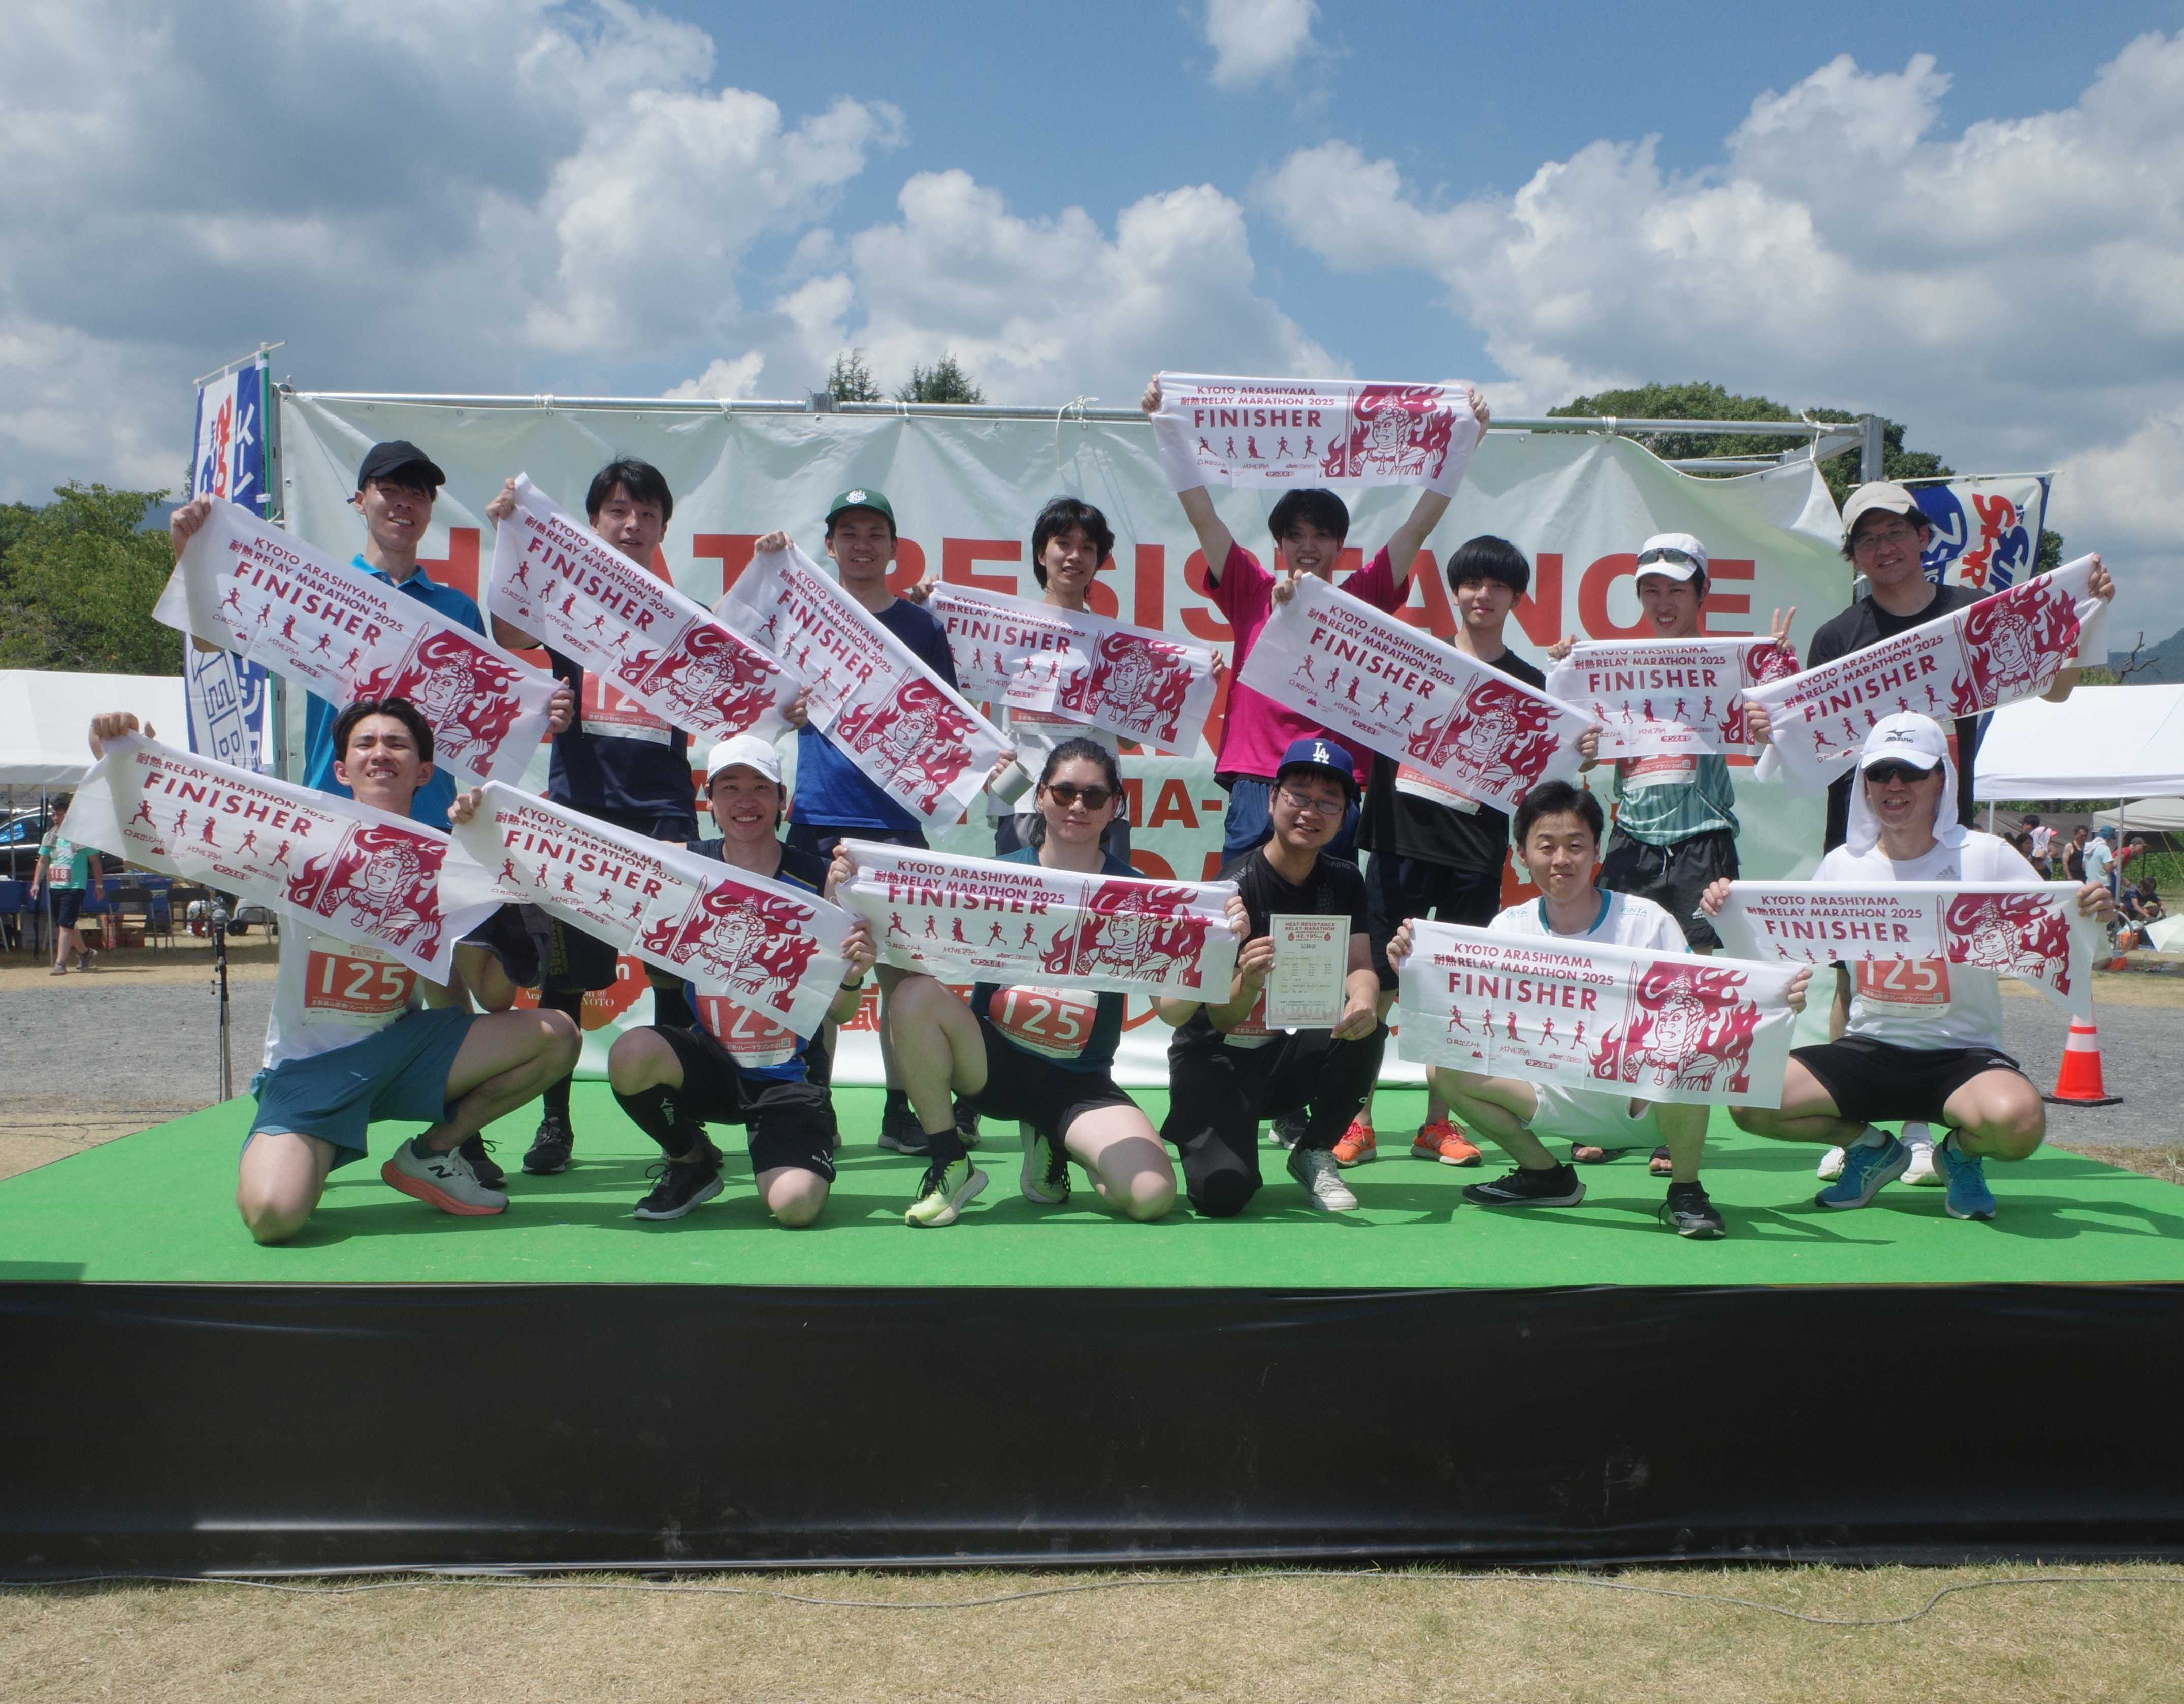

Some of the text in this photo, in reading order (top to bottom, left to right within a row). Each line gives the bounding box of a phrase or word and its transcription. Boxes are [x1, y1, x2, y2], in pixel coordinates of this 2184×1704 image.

[1198, 386, 1316, 395] KYOTO ARASHIYAMA
[1194, 409, 1322, 428] FINISHER
[254, 537, 388, 610] KYOTO ARASHIYAMA
[549, 517, 663, 600] KYOTO ARASHIYAMA
[234, 561, 382, 647] FINISHER
[296, 573, 371, 615] MARATHON
[374, 613, 403, 632] 2025
[527, 536, 654, 632] FINISHER
[581, 555, 647, 600] MARATHON
[648, 598, 676, 619] 2025
[796, 570, 884, 652] KYOTO ARASHIYAMA
[777, 589, 873, 685] FINISHER
[821, 607, 869, 653] MARATHON
[869, 652, 893, 673] 2025
[947, 617, 1070, 655] FINISHER
[1329, 605, 1442, 666] KYOTO ARASHIYAMA
[1310, 627, 1435, 700] FINISHER
[1363, 636, 1427, 671] MARATHON
[1429, 667, 1456, 686] 2025
[1589, 669, 1718, 692] FINISHER
[1633, 657, 1696, 665] MARATHON
[1797, 633, 1921, 691] KYOTO ARASHIYAMA
[1844, 649, 1911, 683] MARATHON
[1915, 635, 1943, 653] 2025
[1803, 655, 1938, 723] FINISHER
[1313, 742, 1329, 764] LA
[144, 771, 312, 838] FINISHER
[212, 776, 297, 809] MARATHON
[518, 806, 663, 867] KYOTO ARASHIYAMA
[568, 835, 646, 871] MARATHON
[51, 869, 66, 879] 118
[504, 830, 662, 899] FINISHER
[897, 861, 1044, 887] KYOTO ARASHIYAMA
[888, 885, 1048, 915] FINISHER
[946, 881, 1027, 899] MARATHON
[1032, 891, 1064, 903] 2025
[1761, 896, 1899, 905] KYOTO ARASHIYAMA
[1810, 908, 1886, 918] MARATHON
[1890, 909, 1922, 919] 2025
[1764, 920, 1910, 943] FINISHER
[1454, 943, 1592, 969] KYOTO ARASHIYAMA
[1501, 962, 1577, 981] MARATHON
[1582, 972, 1614, 986] 2025
[1867, 958, 1937, 990] 125
[322, 957, 407, 1000] 125
[1449, 972, 1596, 1012] FINISHER
[1002, 992, 1084, 1039] 125
